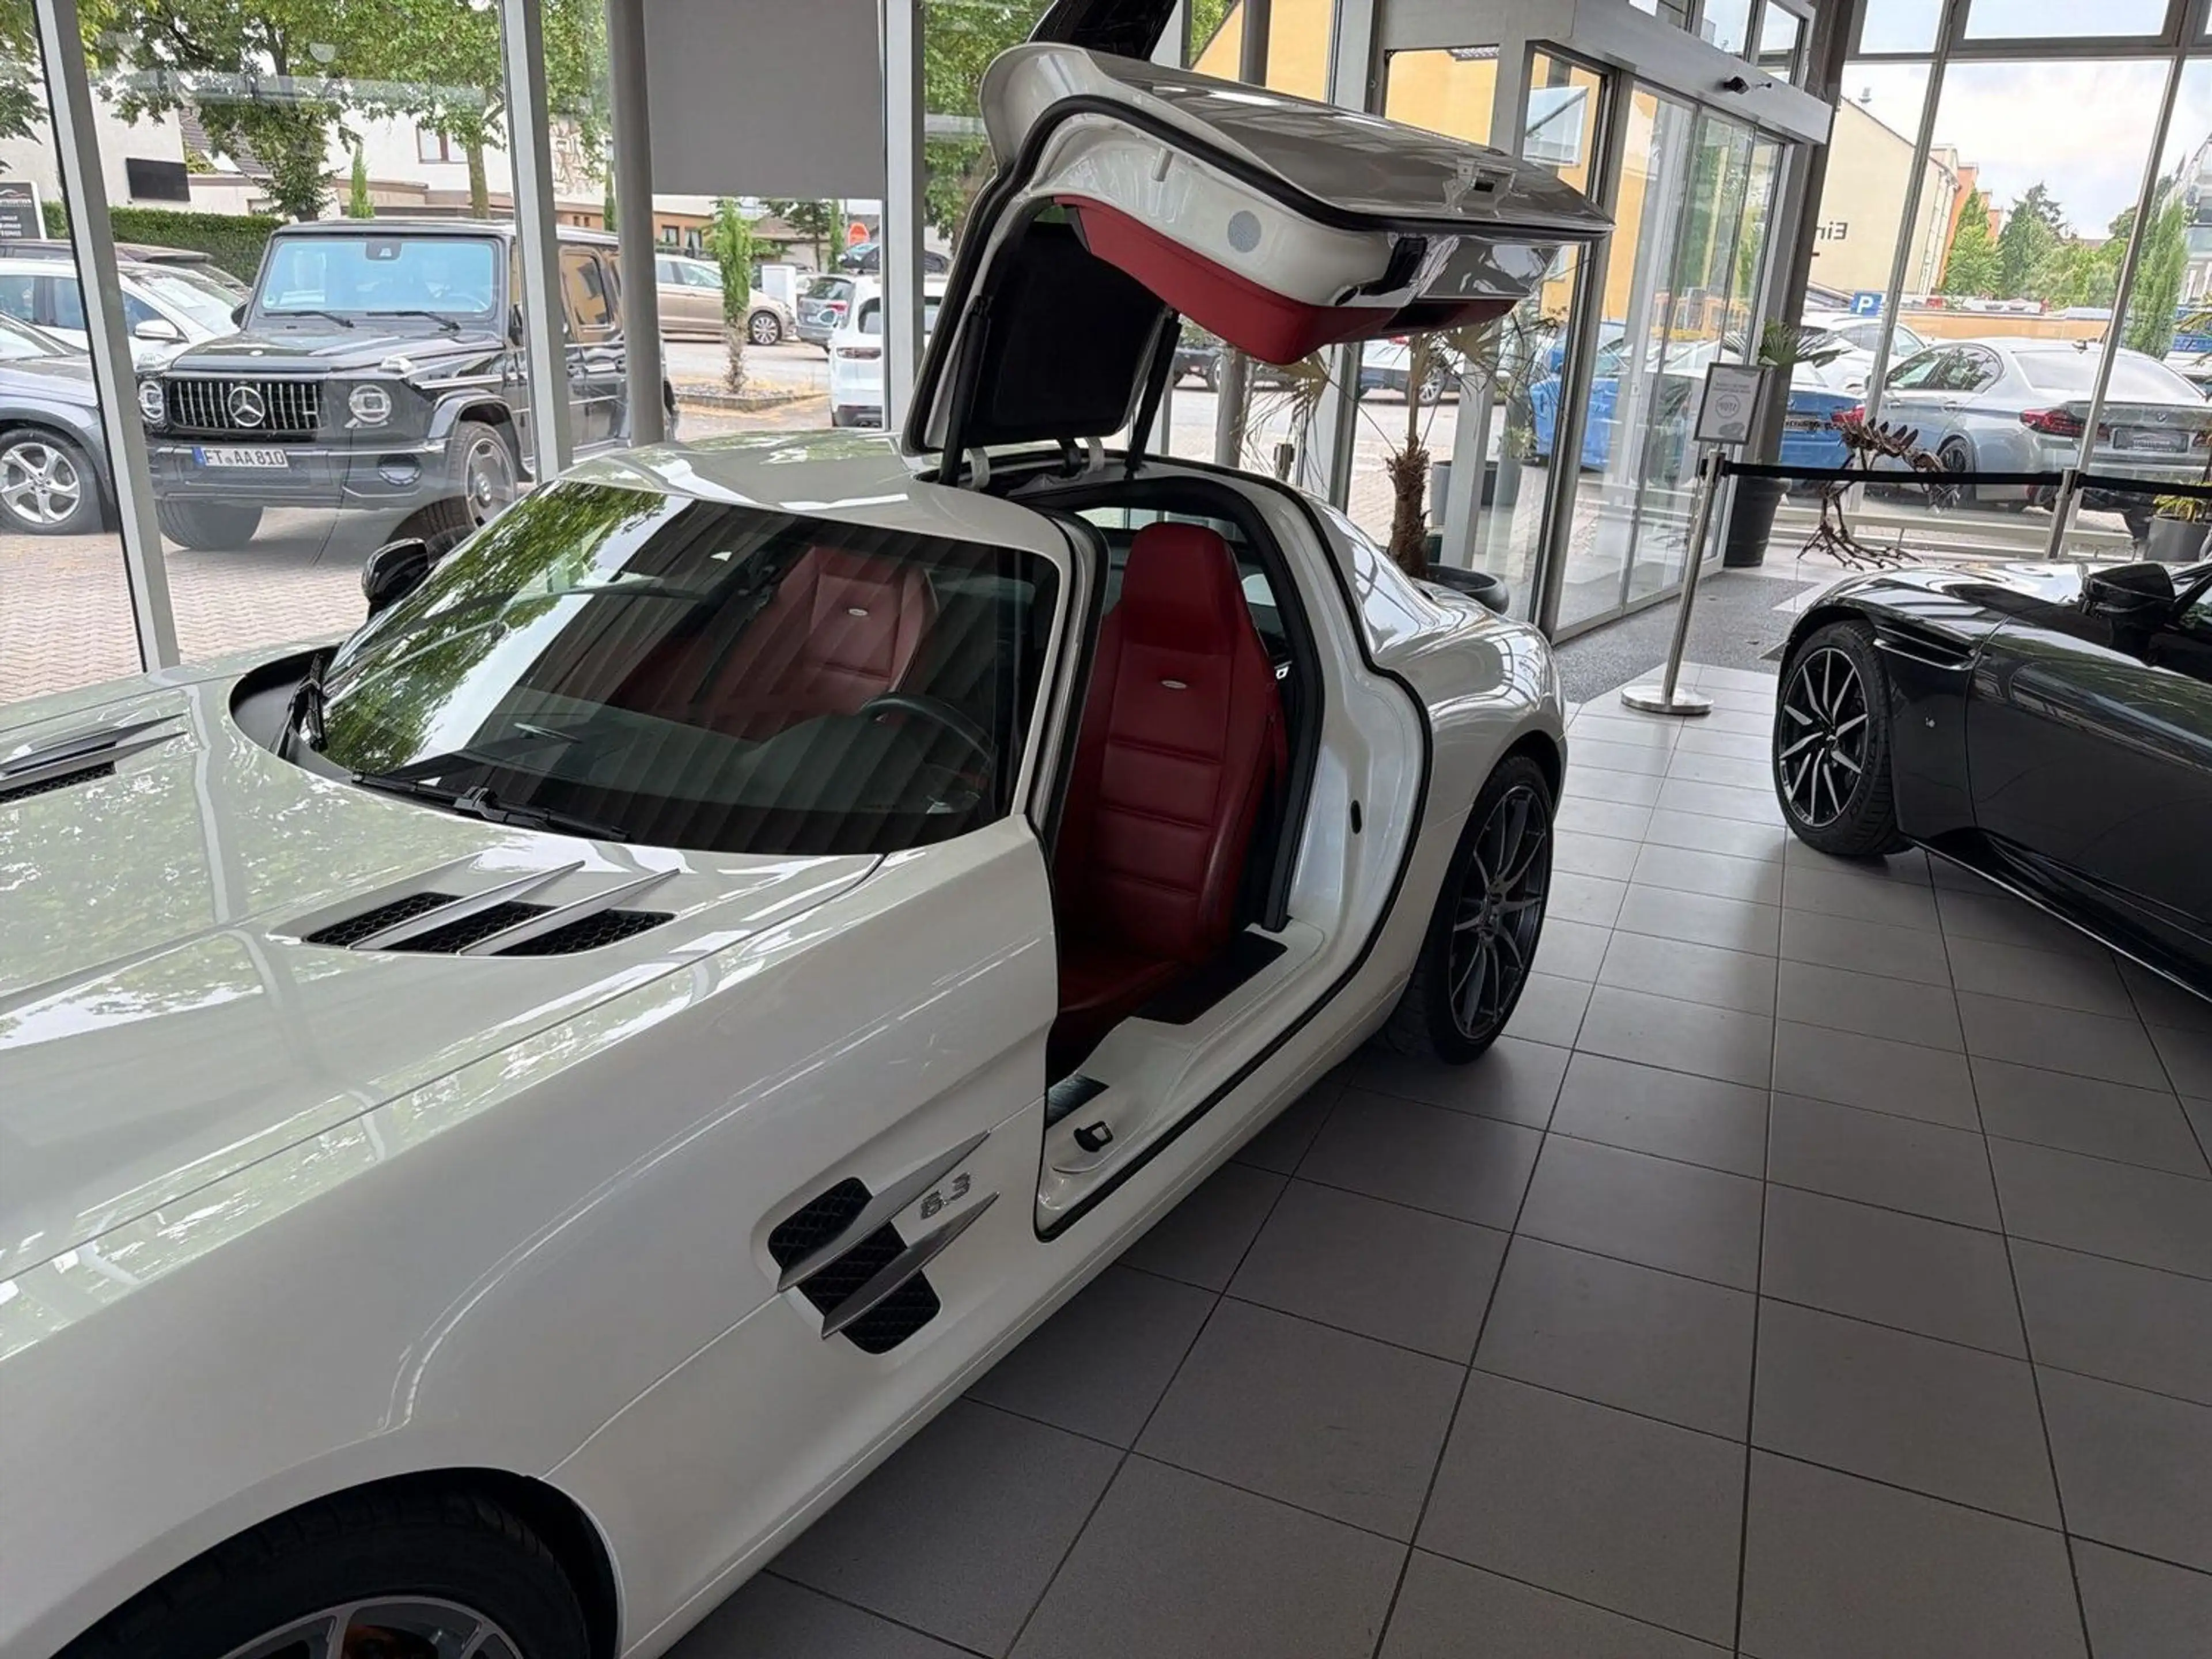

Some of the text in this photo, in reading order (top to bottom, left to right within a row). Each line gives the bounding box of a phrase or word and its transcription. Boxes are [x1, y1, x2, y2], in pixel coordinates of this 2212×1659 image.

[1857, 296, 1874, 313] P
[203, 450, 222, 464] FT
[921, 1172, 971, 1220] 6.3
